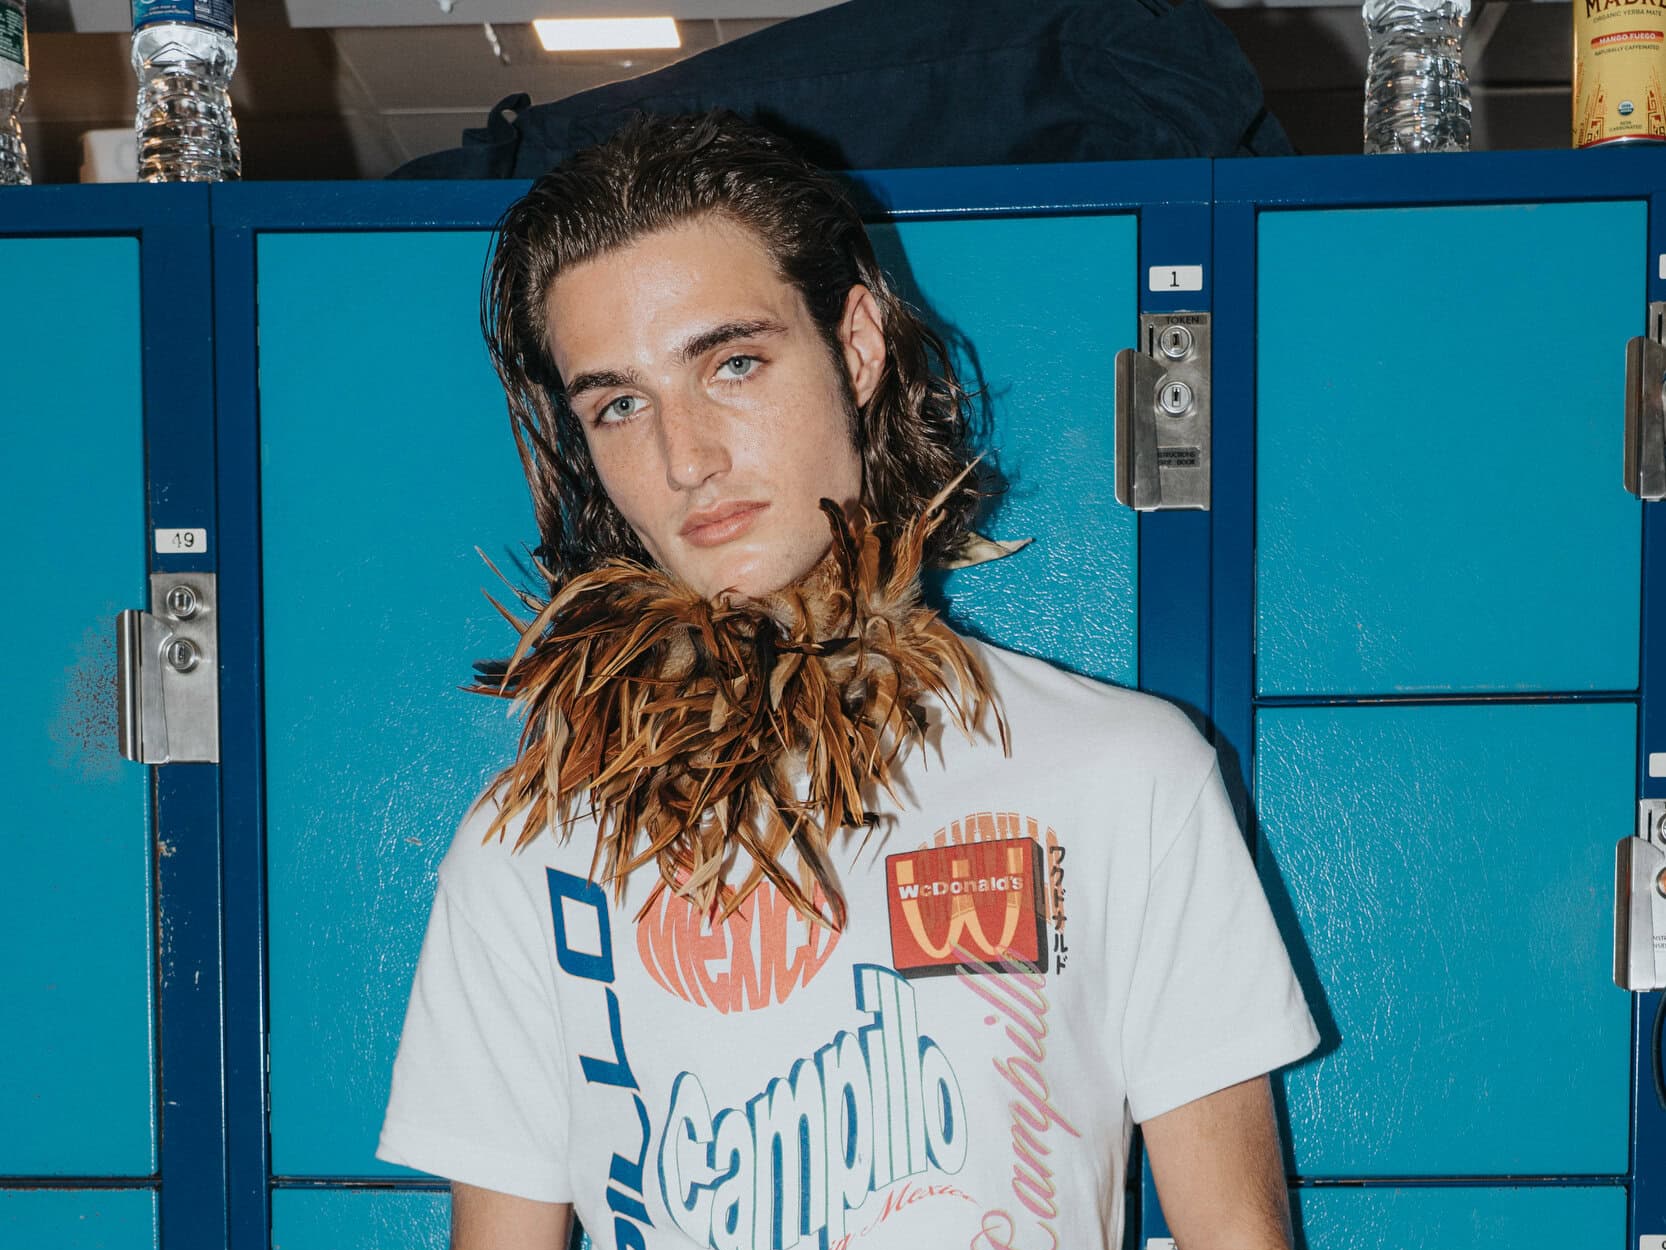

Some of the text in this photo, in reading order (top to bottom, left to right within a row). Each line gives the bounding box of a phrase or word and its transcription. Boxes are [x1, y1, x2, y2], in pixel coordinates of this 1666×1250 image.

[1600, 34, 1628, 44] MANGO
[1169, 271, 1180, 288] 1
[1166, 315, 1199, 325] TOKEN
